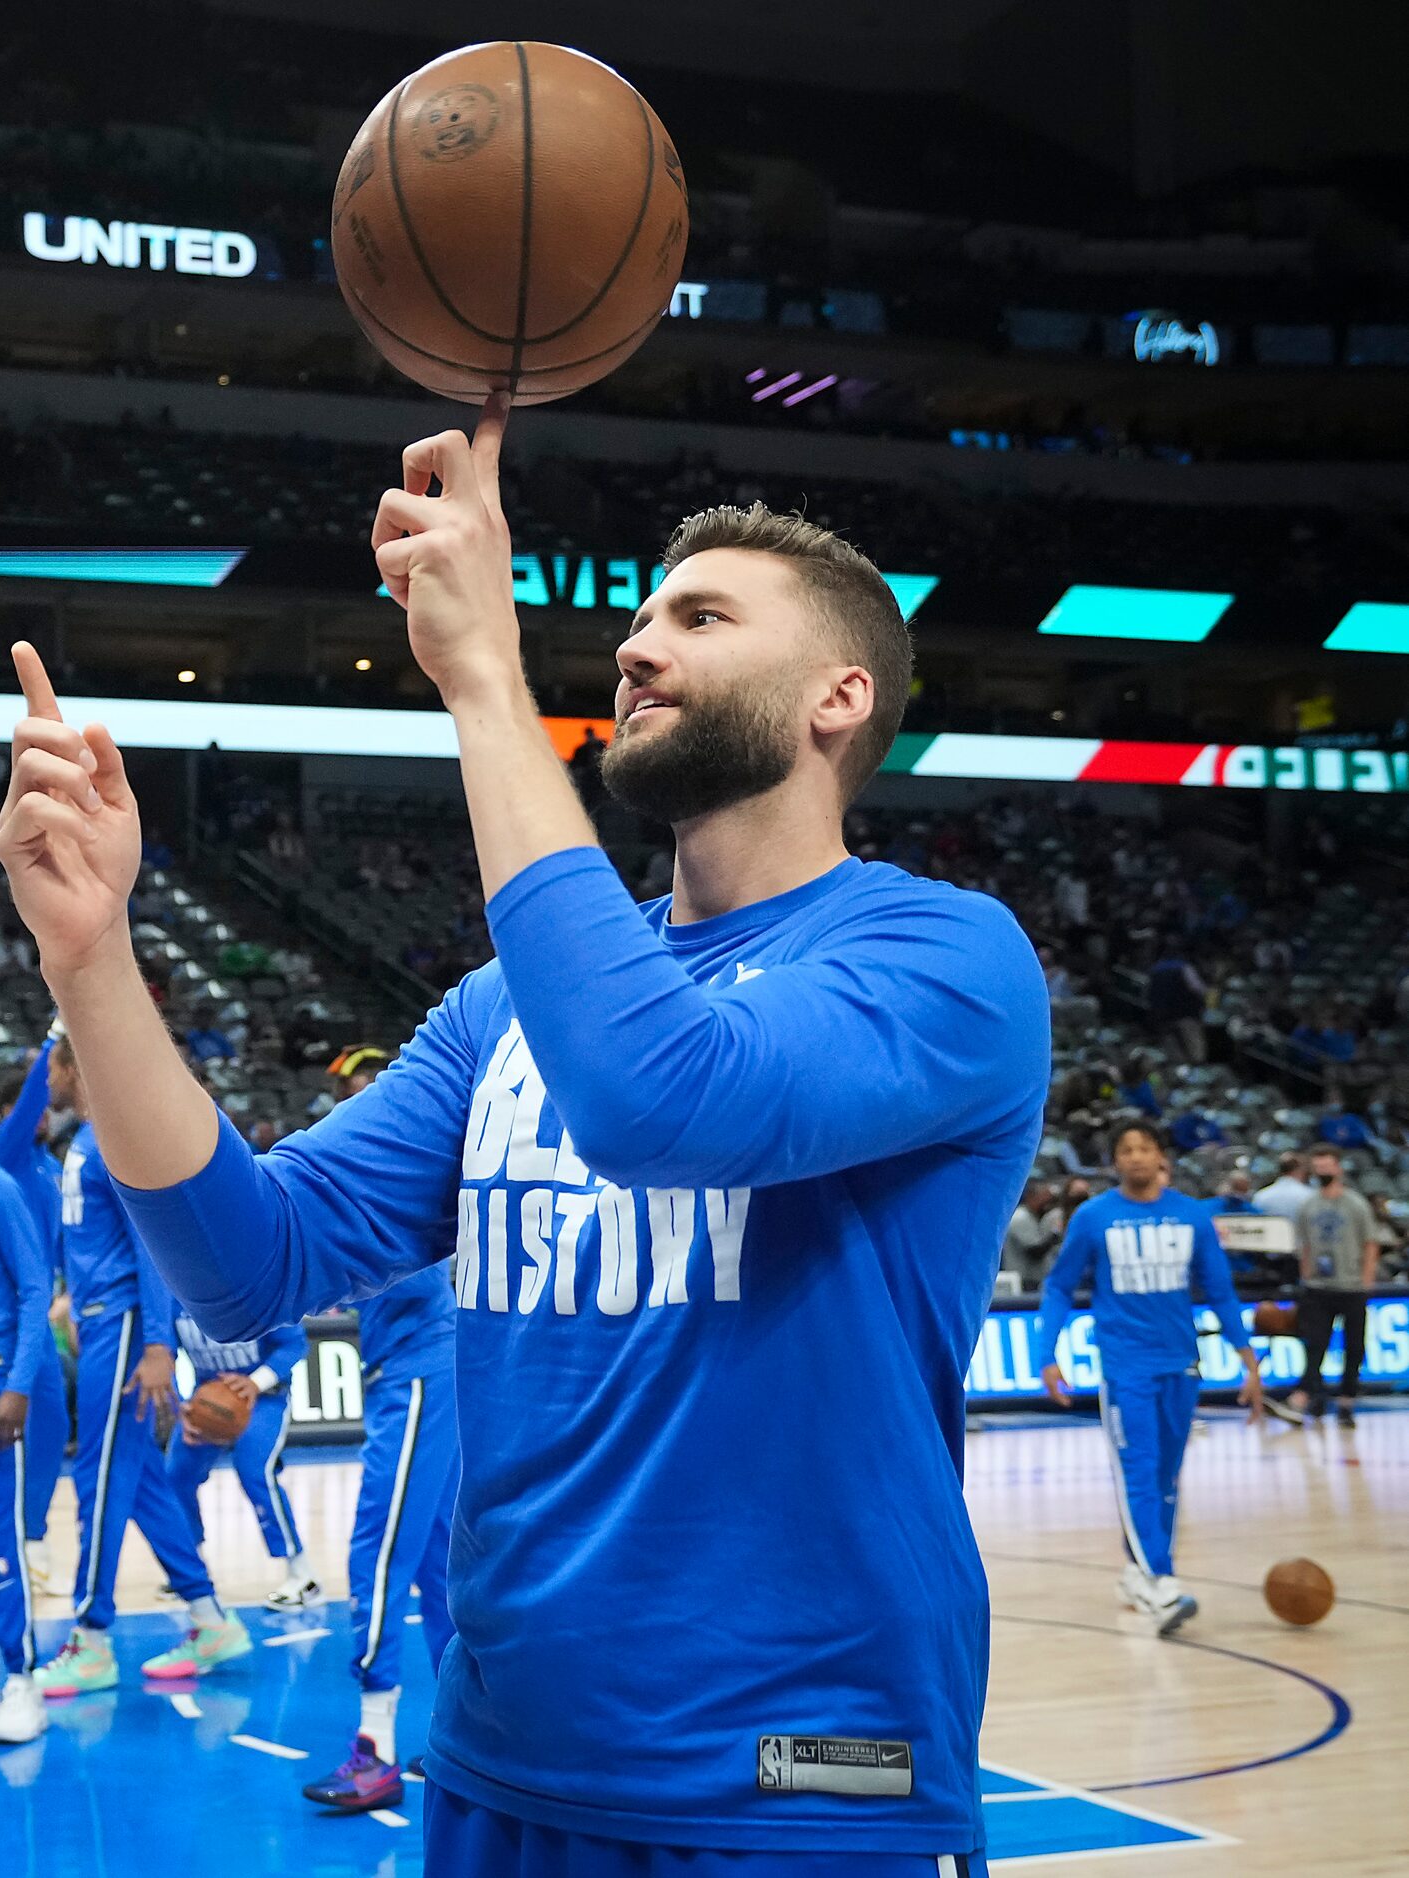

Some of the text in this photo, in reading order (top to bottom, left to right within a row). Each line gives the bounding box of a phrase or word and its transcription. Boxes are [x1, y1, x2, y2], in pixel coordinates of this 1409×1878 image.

[22, 211, 259, 279] UNITED
[456, 1186, 751, 1316] HISTORY
[794, 1744, 818, 1759] XLT
